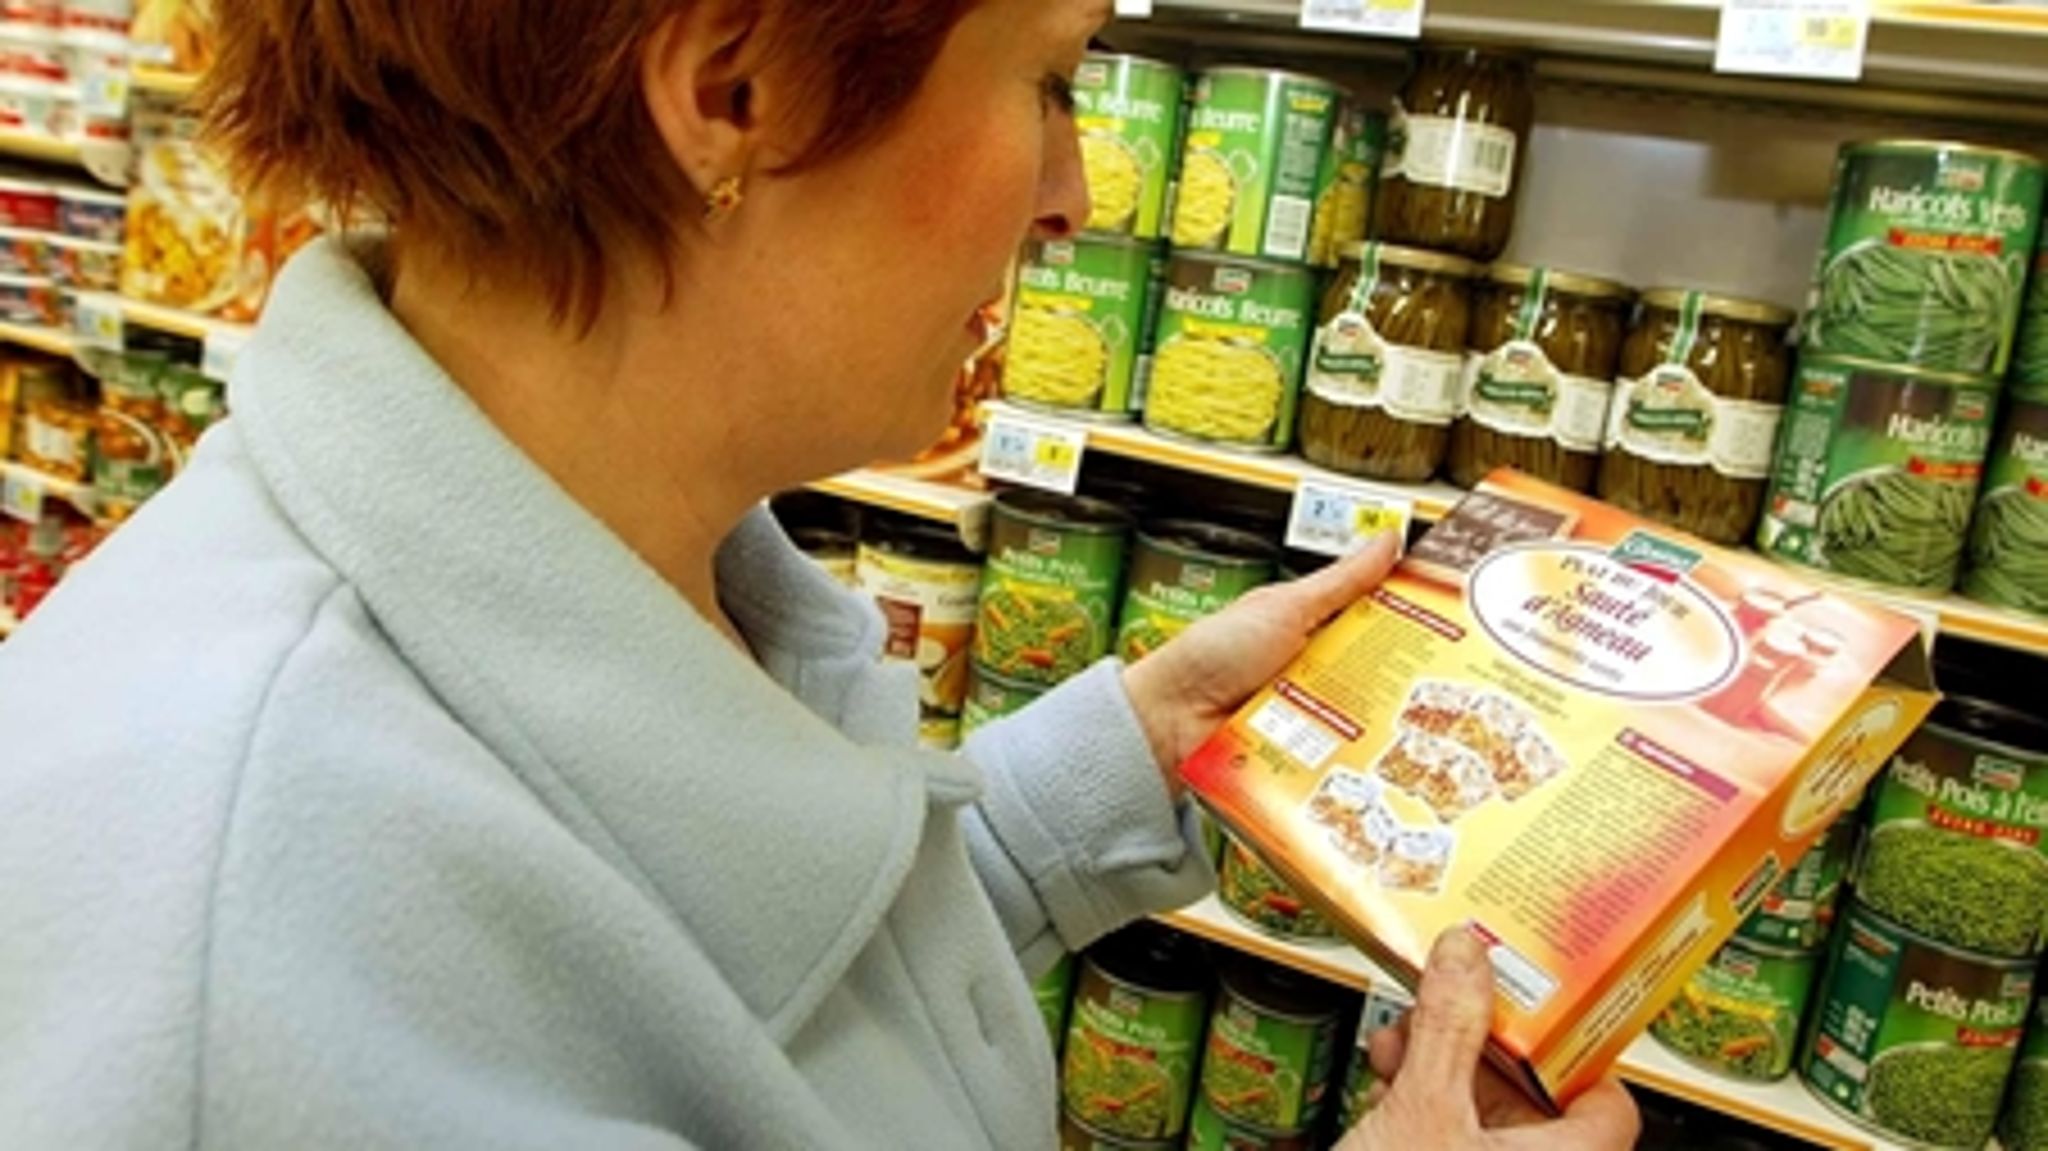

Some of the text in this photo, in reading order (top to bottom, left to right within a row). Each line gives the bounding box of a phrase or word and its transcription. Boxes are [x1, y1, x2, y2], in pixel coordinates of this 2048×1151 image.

[1869, 184, 1973, 220] Haricots
[1521, 594, 1654, 664] d'Agneau
[1938, 776, 1991, 816] Pois
[1906, 980, 1968, 1021] Petits
